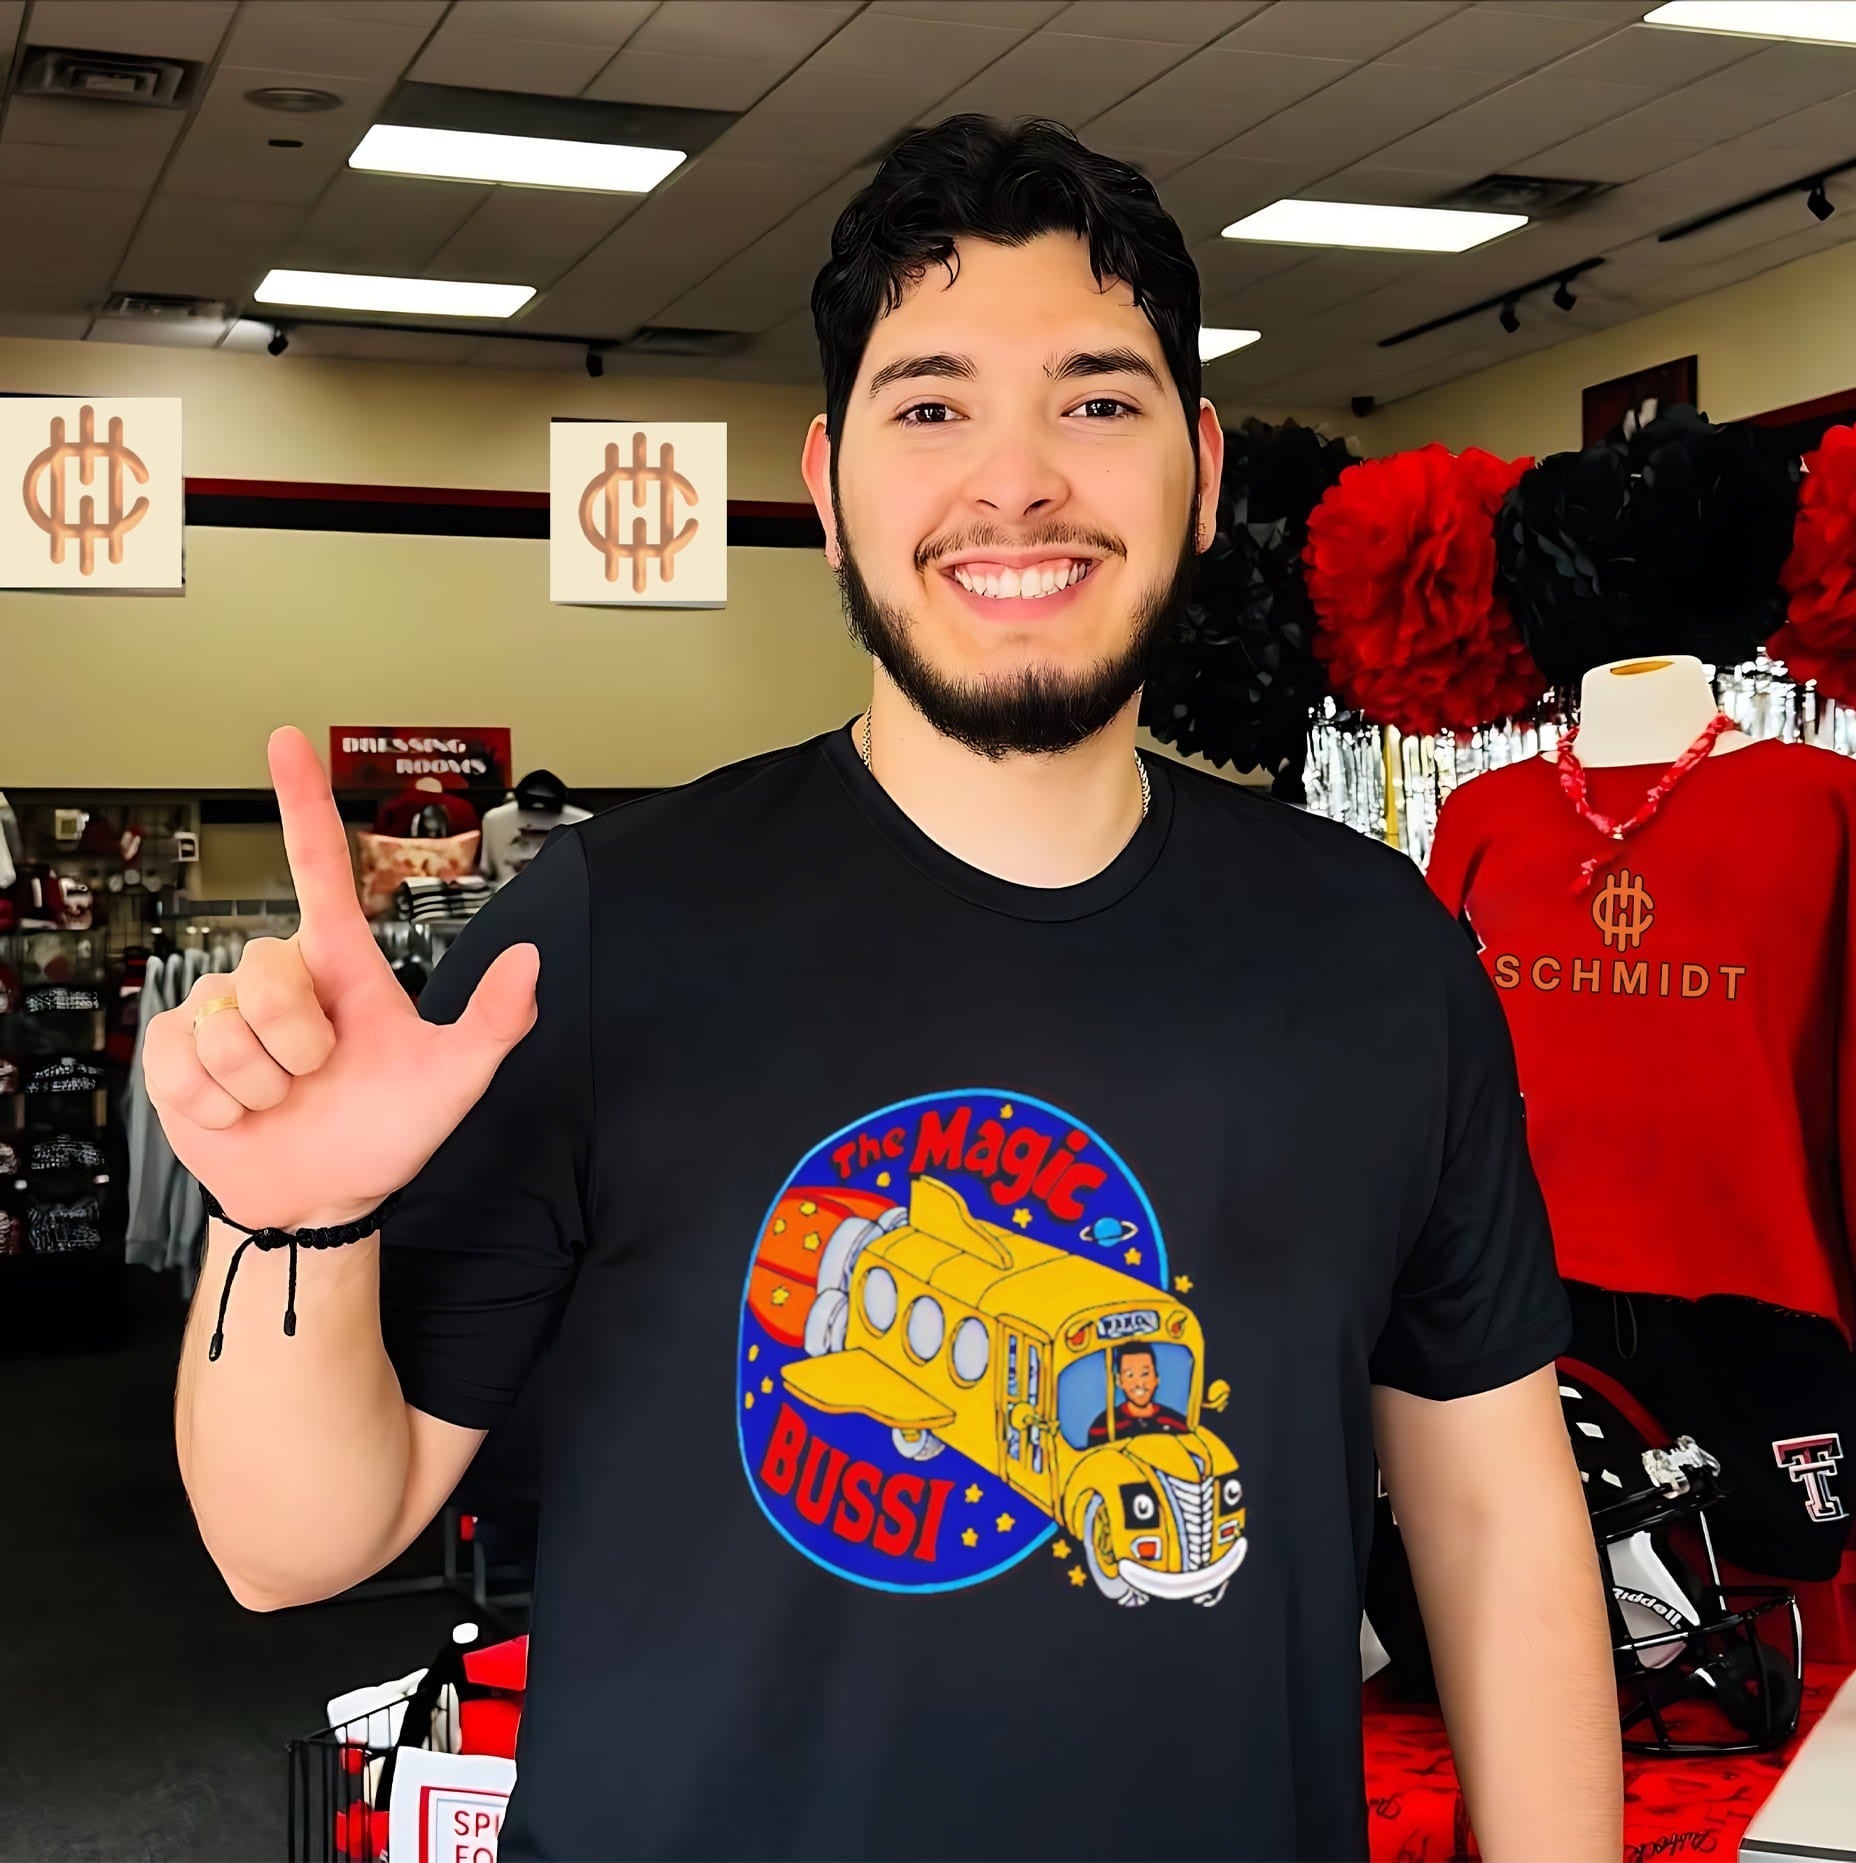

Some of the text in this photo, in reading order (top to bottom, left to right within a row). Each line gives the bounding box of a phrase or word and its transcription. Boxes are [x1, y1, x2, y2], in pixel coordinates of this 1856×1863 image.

[396, 758, 487, 775] ROOMS
[1494, 953, 1746, 1001] SCHMIDT
[832, 1106, 1108, 1220] The Magic
[760, 1402, 955, 1562] BUSSI
